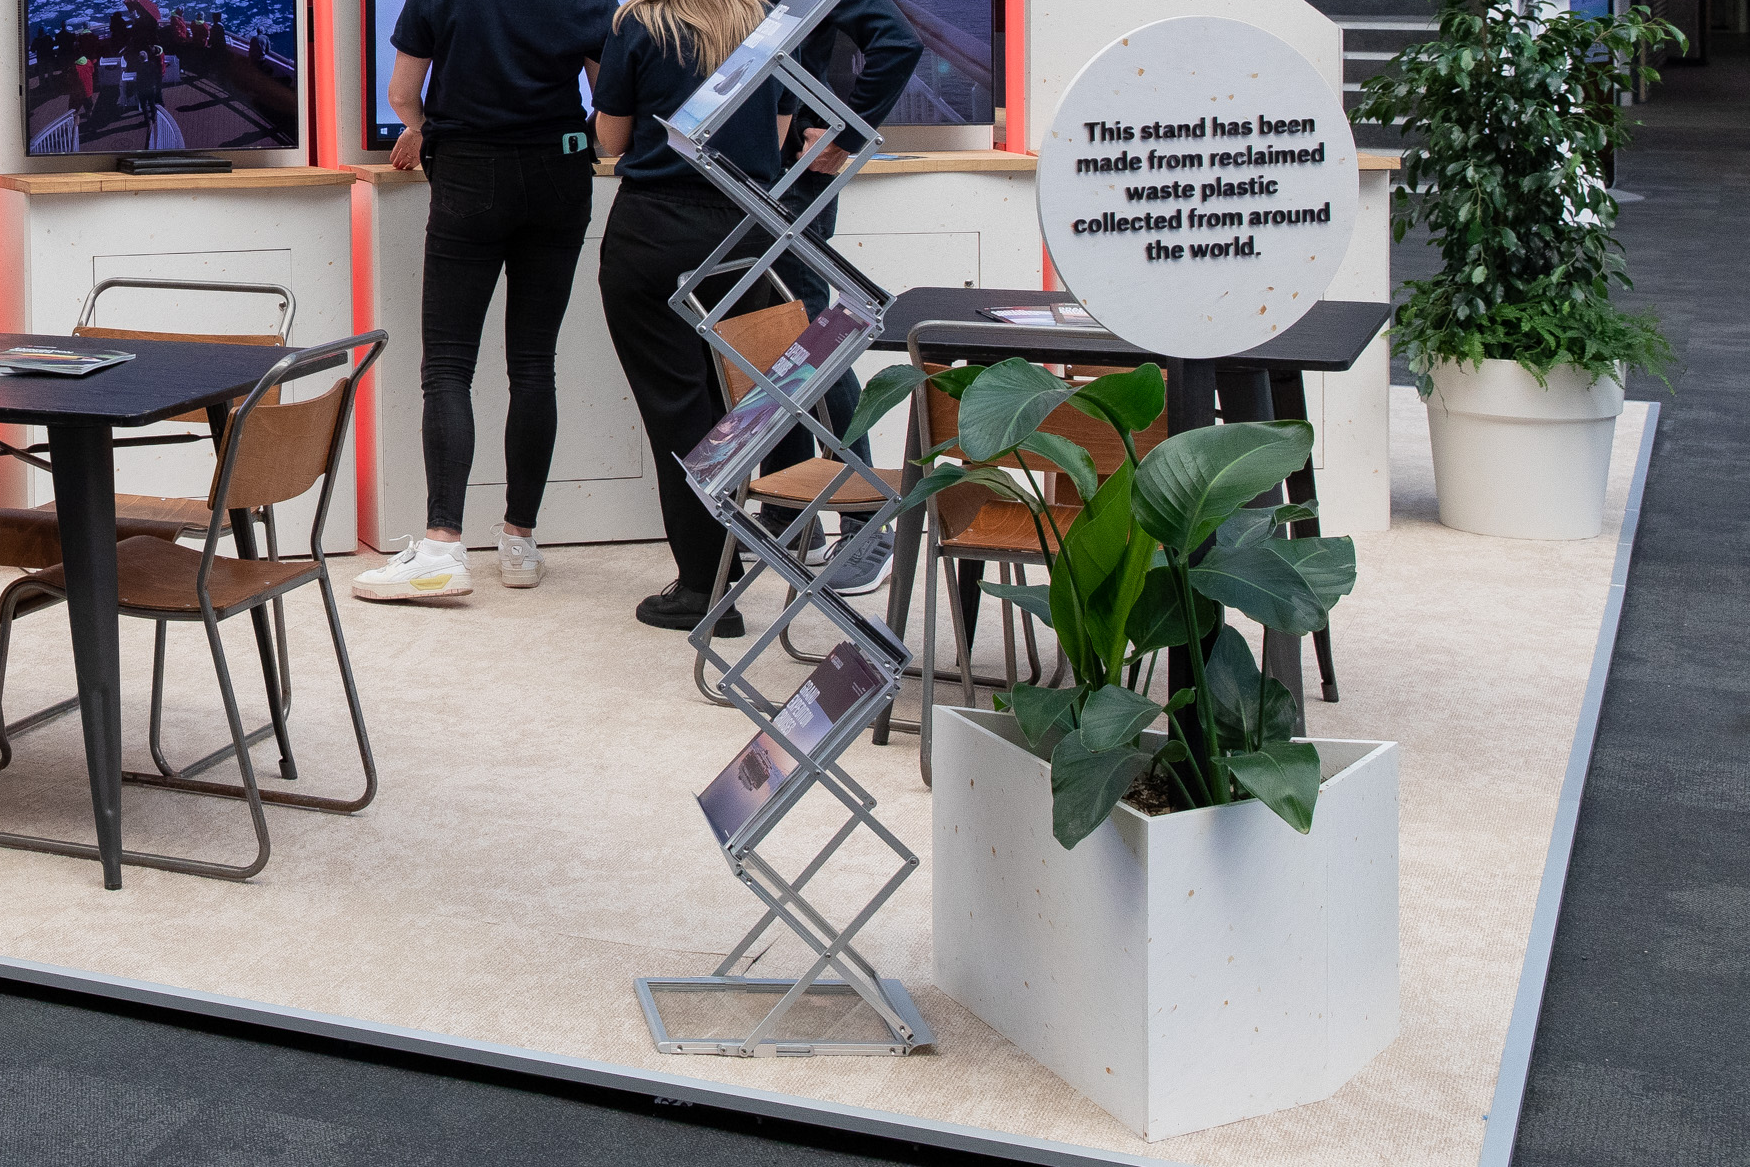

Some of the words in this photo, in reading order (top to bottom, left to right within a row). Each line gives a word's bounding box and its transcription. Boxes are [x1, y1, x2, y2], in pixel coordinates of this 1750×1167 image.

[1085, 121, 1135, 142] This
[1141, 117, 1206, 140] stand
[1212, 116, 1253, 138] has
[1259, 114, 1316, 136] been
[1076, 151, 1142, 173] made
[1147, 149, 1203, 170] from
[1210, 142, 1325, 167] reclaimed
[1125, 181, 1195, 201] waste
[1201, 175, 1278, 202] plastic
[1072, 209, 1182, 234] collected
[1188, 207, 1243, 229] from
[1249, 202, 1331, 226] around
[1145, 239, 1184, 261] the
[1189, 235, 1262, 259] world.
